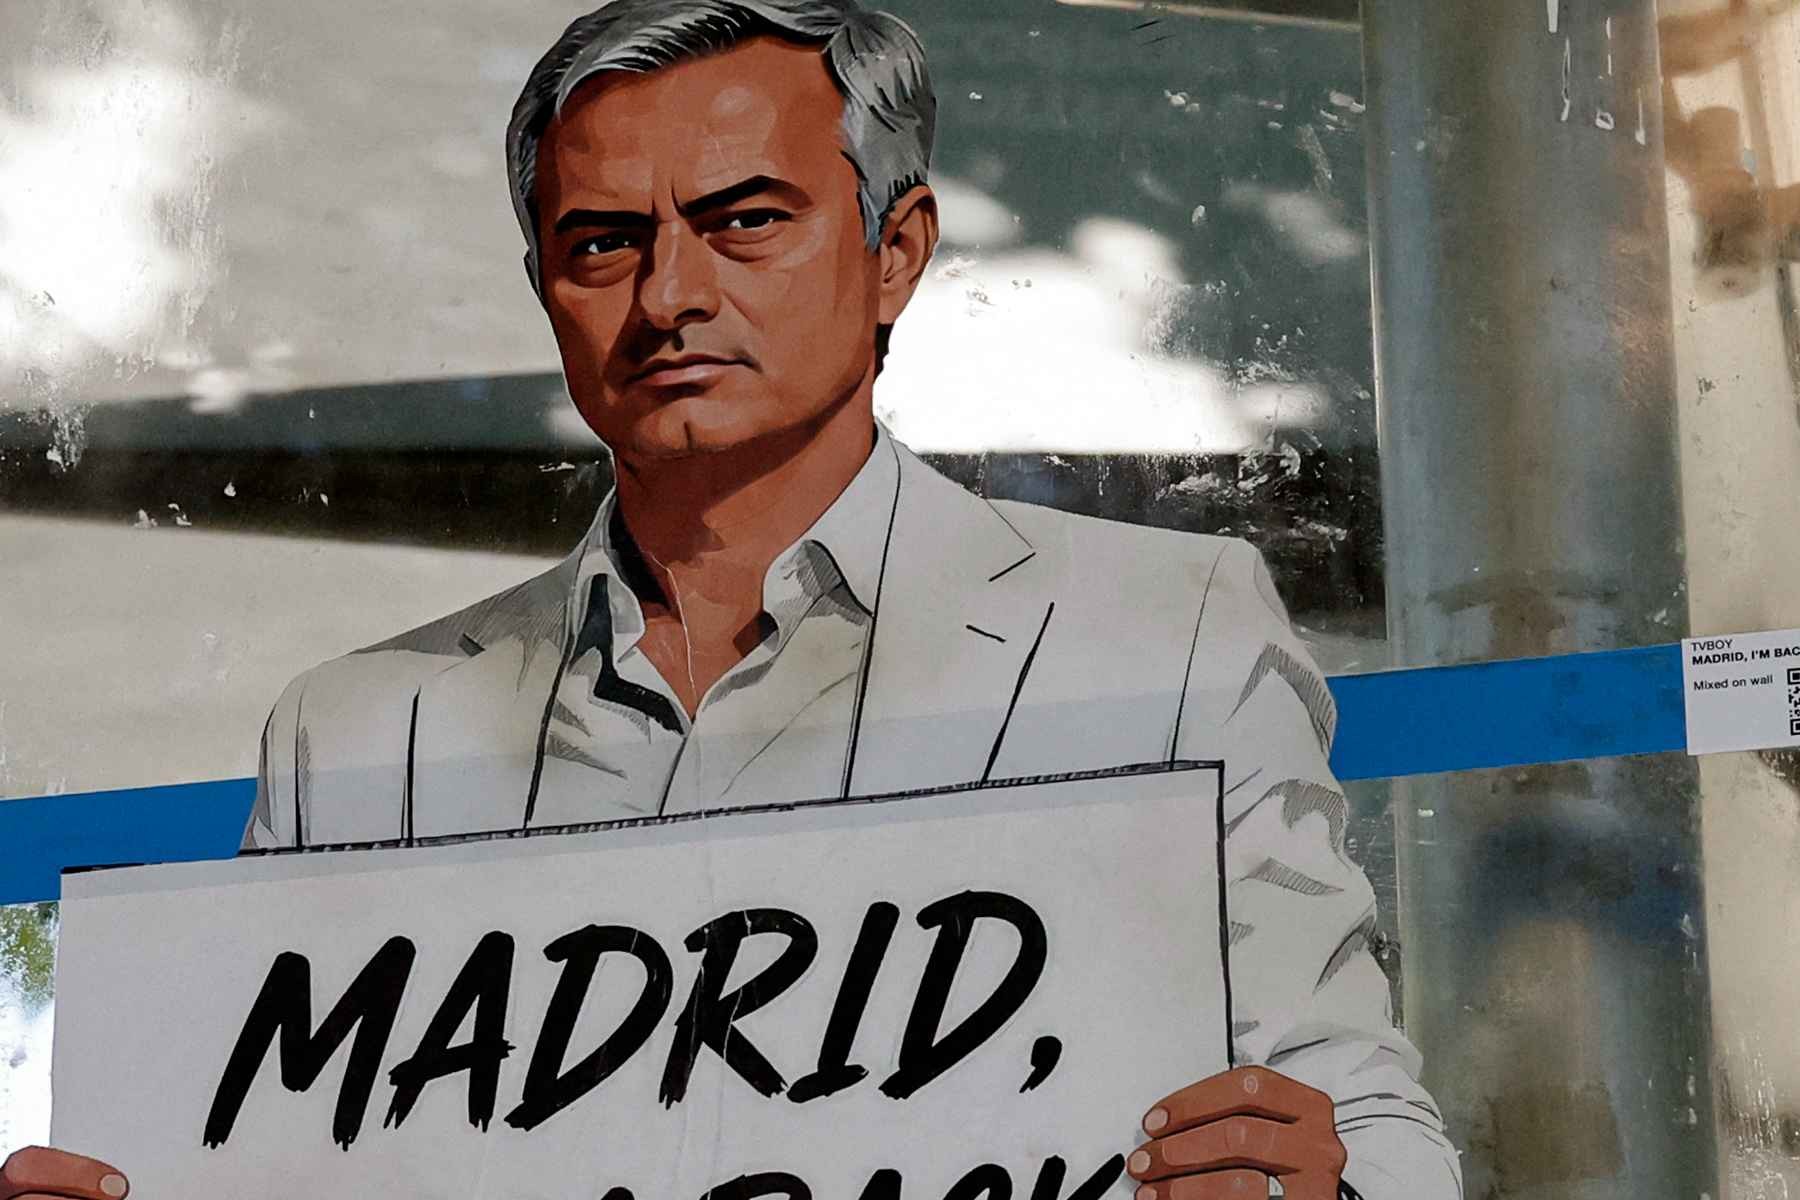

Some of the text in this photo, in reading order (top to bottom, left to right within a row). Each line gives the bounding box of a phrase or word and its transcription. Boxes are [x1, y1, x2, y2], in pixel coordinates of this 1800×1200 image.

[1691, 638, 1733, 652] TVBOY
[1692, 651, 1748, 666] MADRID,
[1751, 649, 1771, 661] I'M
[1693, 674, 1774, 691] Mixed on wall
[202, 889, 1063, 1152] MADRID,
